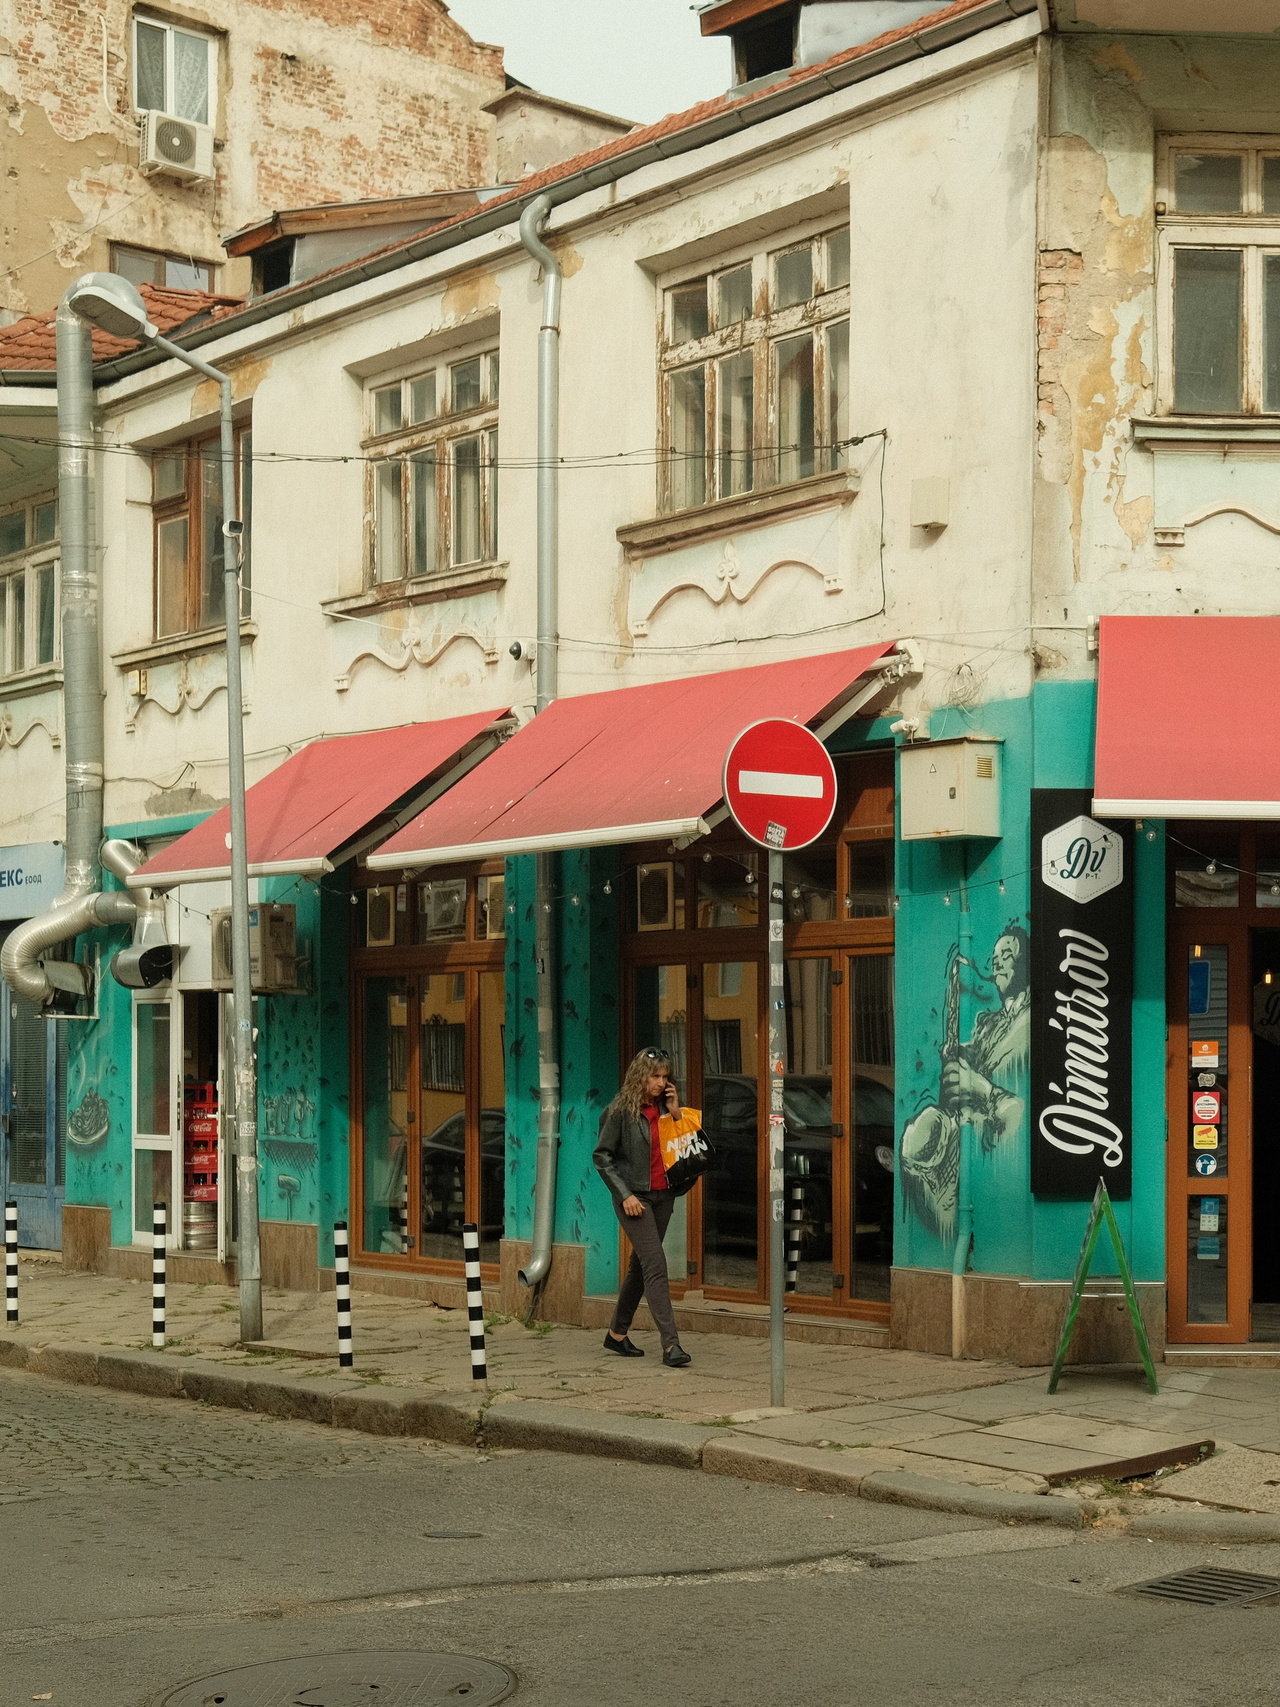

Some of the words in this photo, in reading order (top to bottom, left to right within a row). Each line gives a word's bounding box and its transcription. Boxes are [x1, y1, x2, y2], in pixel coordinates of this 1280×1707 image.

[1060, 837, 1106, 879] Dv
[25, 874, 42, 885] ЕООД
[1039, 928, 1123, 1168] Dimitrov
[675, 1140, 709, 1162] MAN
